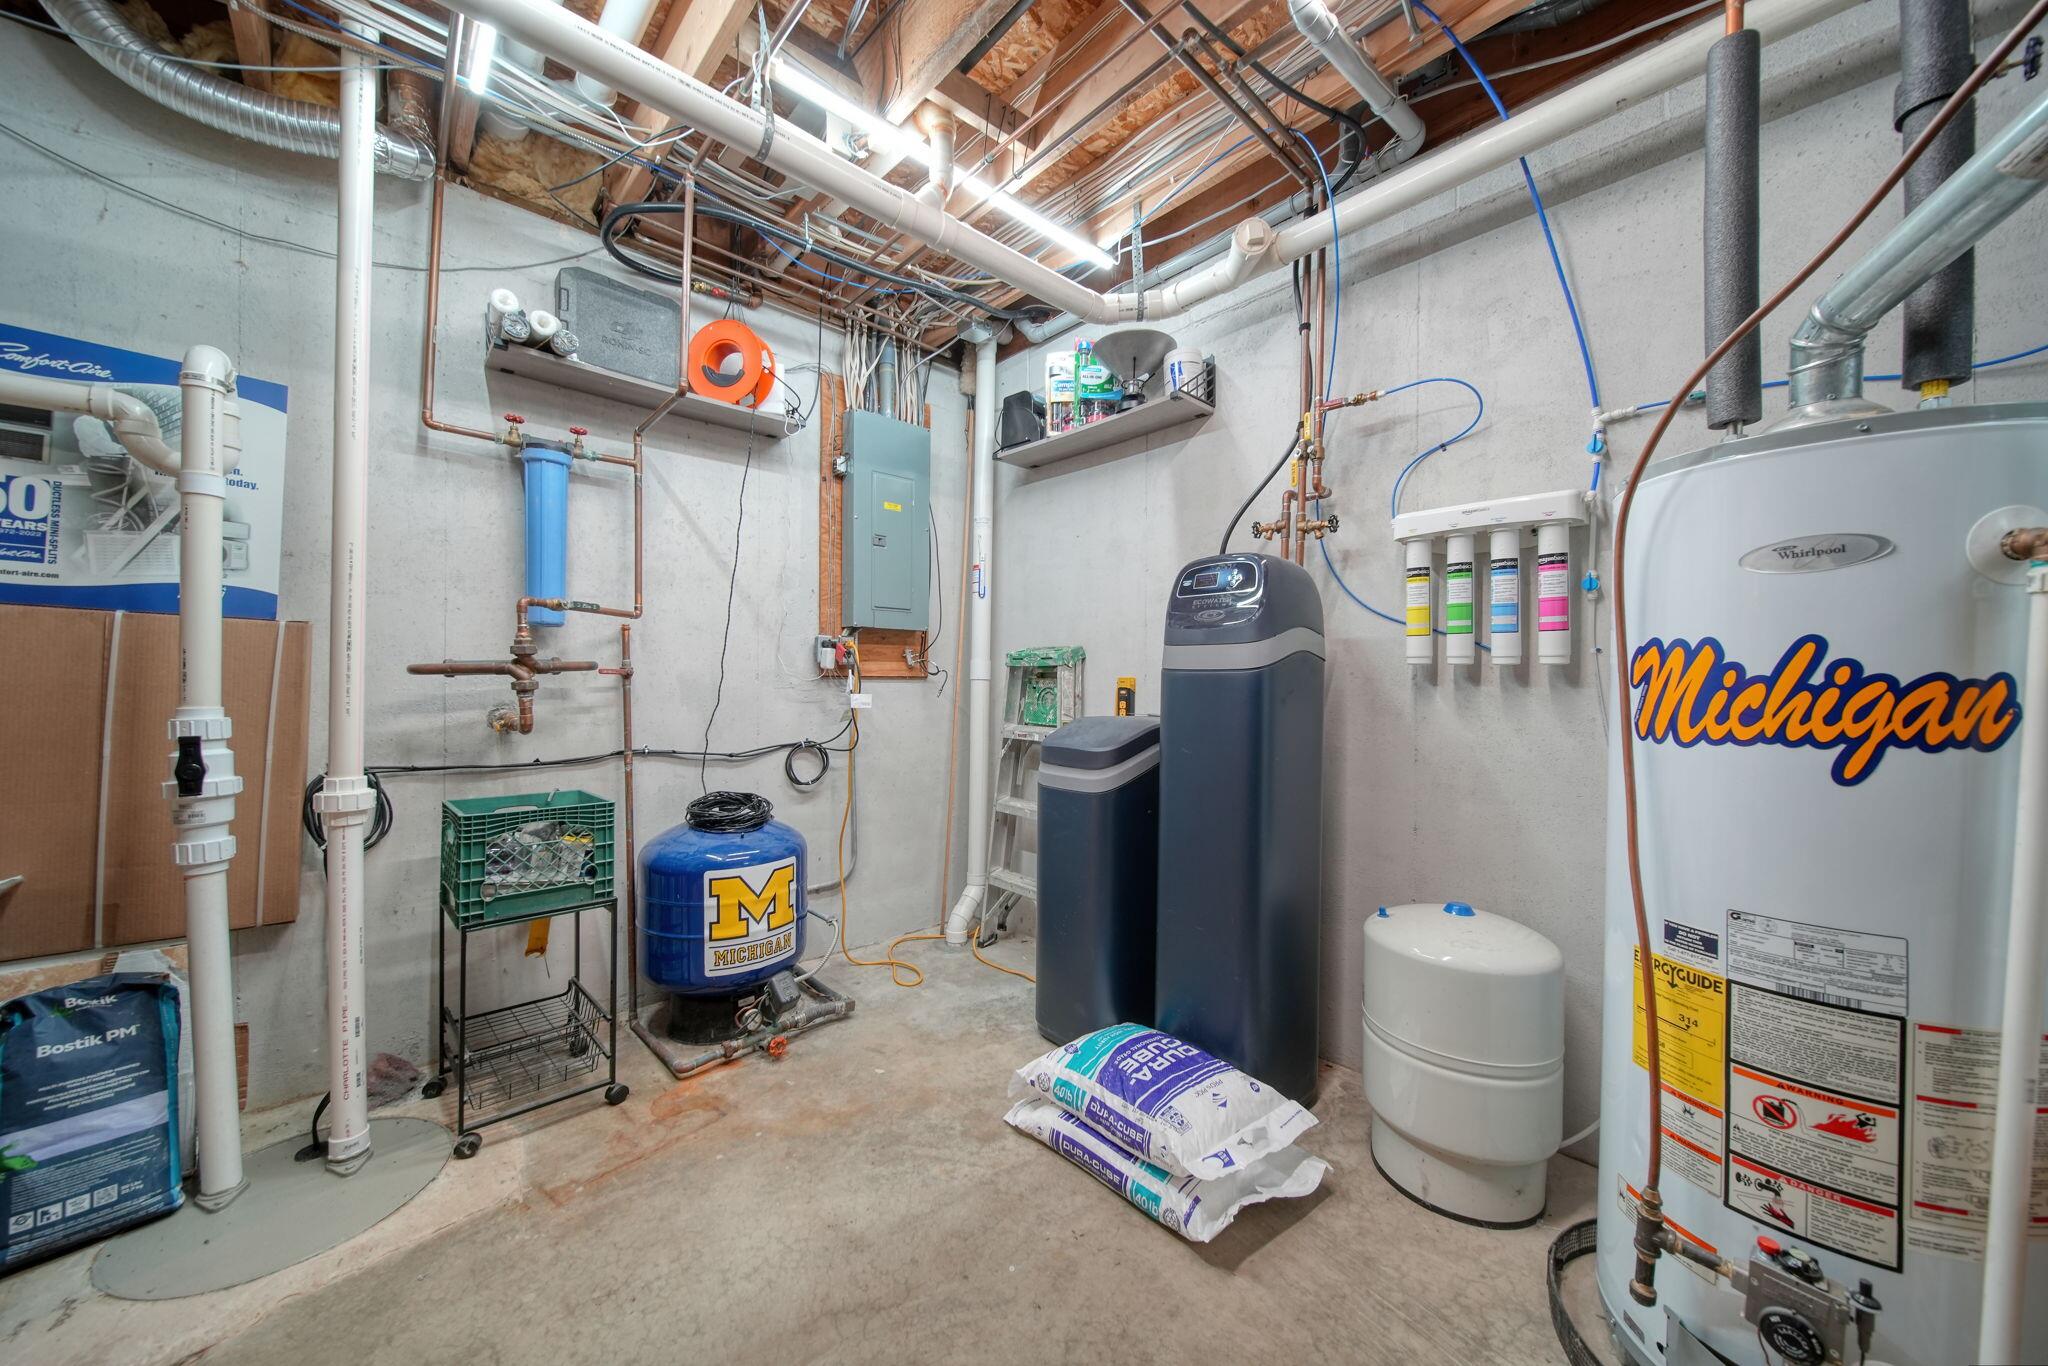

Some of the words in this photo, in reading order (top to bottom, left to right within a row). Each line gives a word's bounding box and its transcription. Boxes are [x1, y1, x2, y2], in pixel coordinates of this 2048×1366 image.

[0, 474, 51, 520] 0
[50, 481, 62, 519] DUCTLESS
[0, 518, 48, 532] EARS
[0, 528, 42, 538] 72-2022
[47, 519, 60, 565] MINI-SPLITS
[1778, 544, 1846, 562] Whirlpool
[1632, 638, 2019, 783] Michigan
[709, 863, 795, 941] M
[713, 932, 792, 967] MICHIGAN
[1634, 949, 1723, 994] ERGYGUIDE
[1678, 1013, 1699, 1028] 314
[36, 1034, 103, 1059] Bostik
[1118, 1038, 1182, 1074] CUBE
[1785, 1084, 1844, 1106] WARNING
[1790, 1180, 1841, 1203] DANGER
